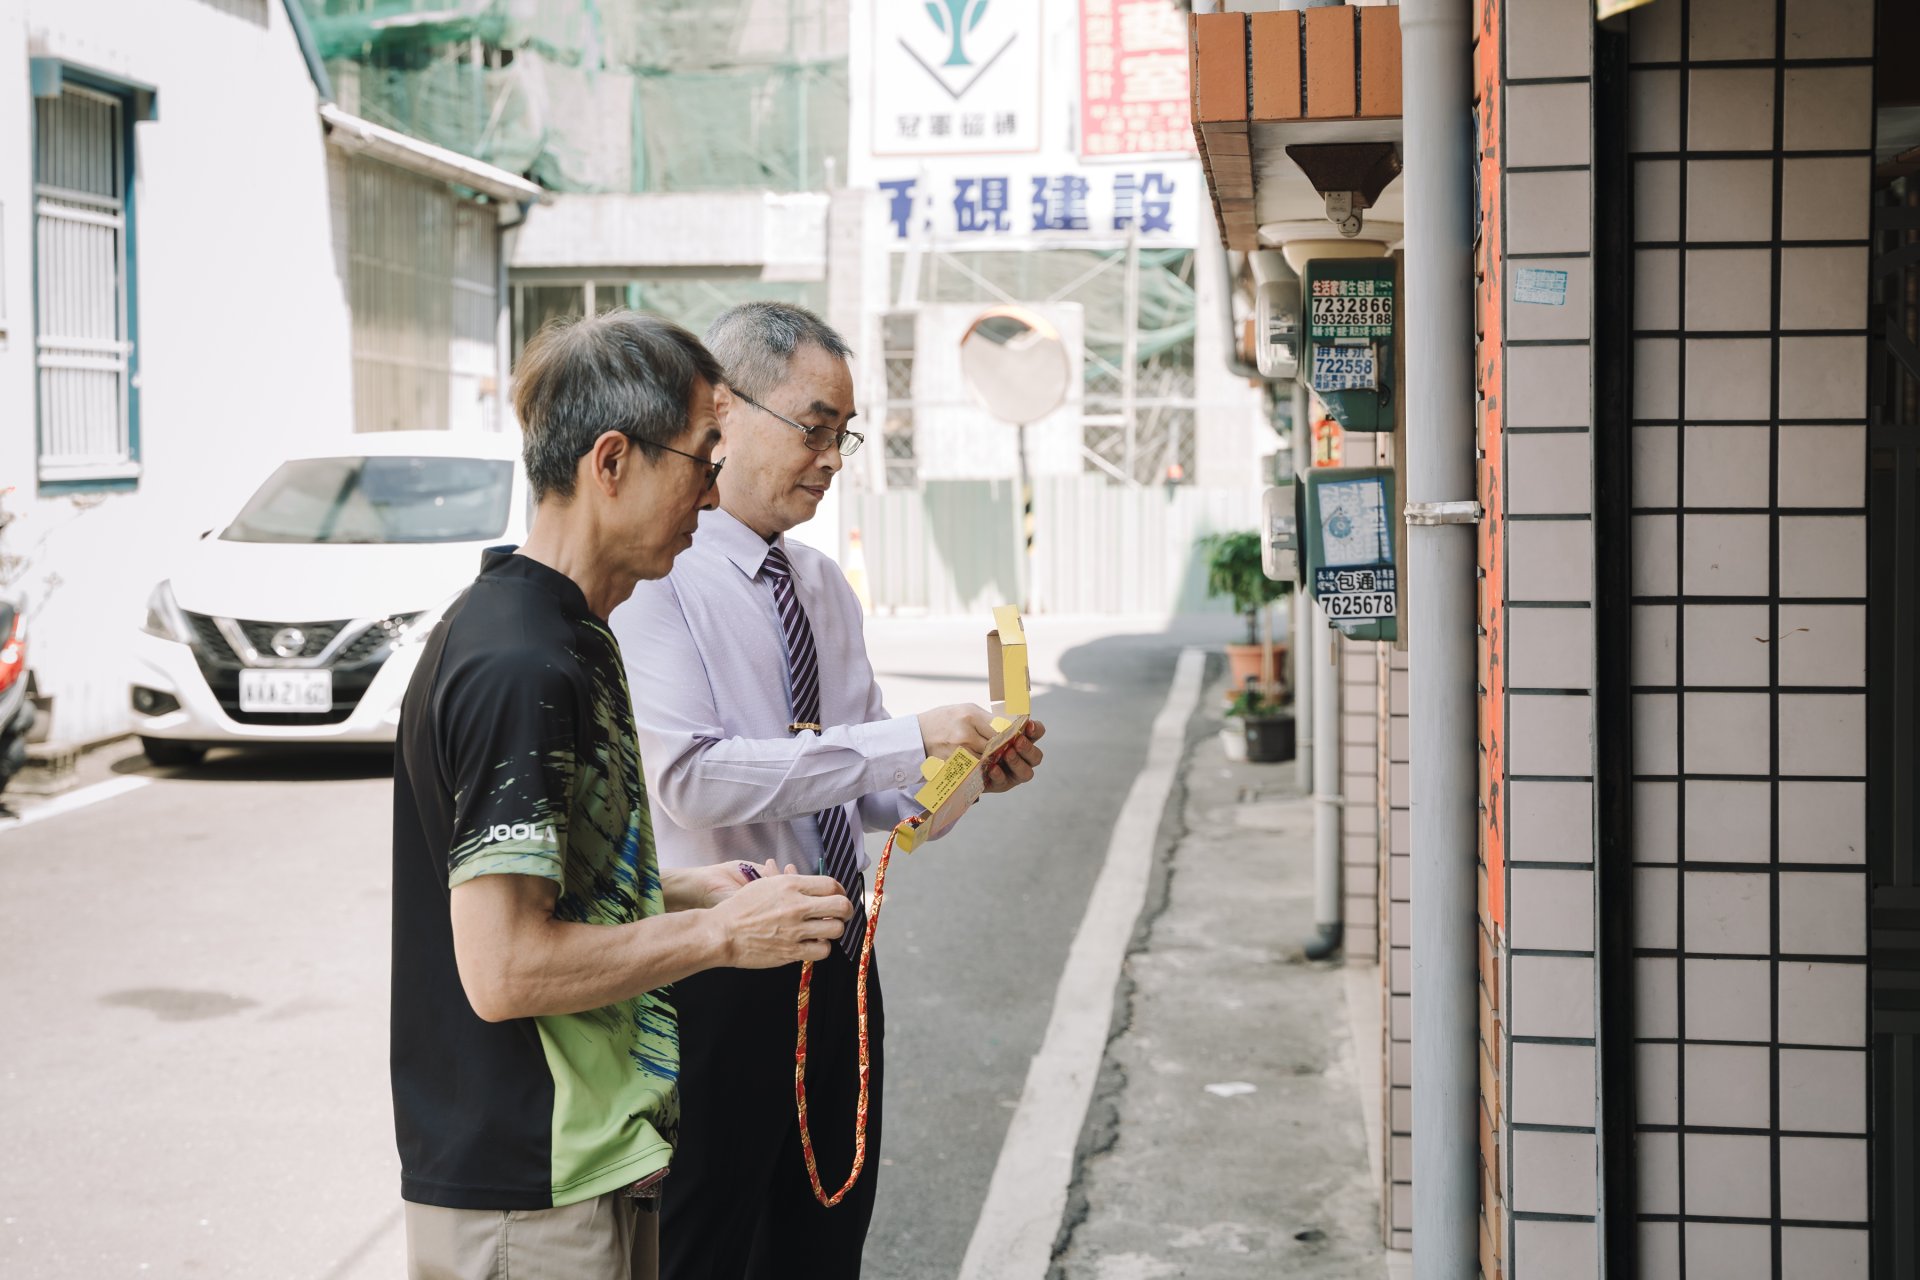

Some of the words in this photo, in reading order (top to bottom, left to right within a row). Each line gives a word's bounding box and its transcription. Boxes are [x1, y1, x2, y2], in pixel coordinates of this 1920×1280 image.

[1313, 298, 1391, 313] 7232866
[1313, 313, 1392, 325] 0932265188
[1316, 358, 1373, 374] 722558
[1336, 571, 1376, 592] 包通
[1321, 594, 1393, 615] 7625678
